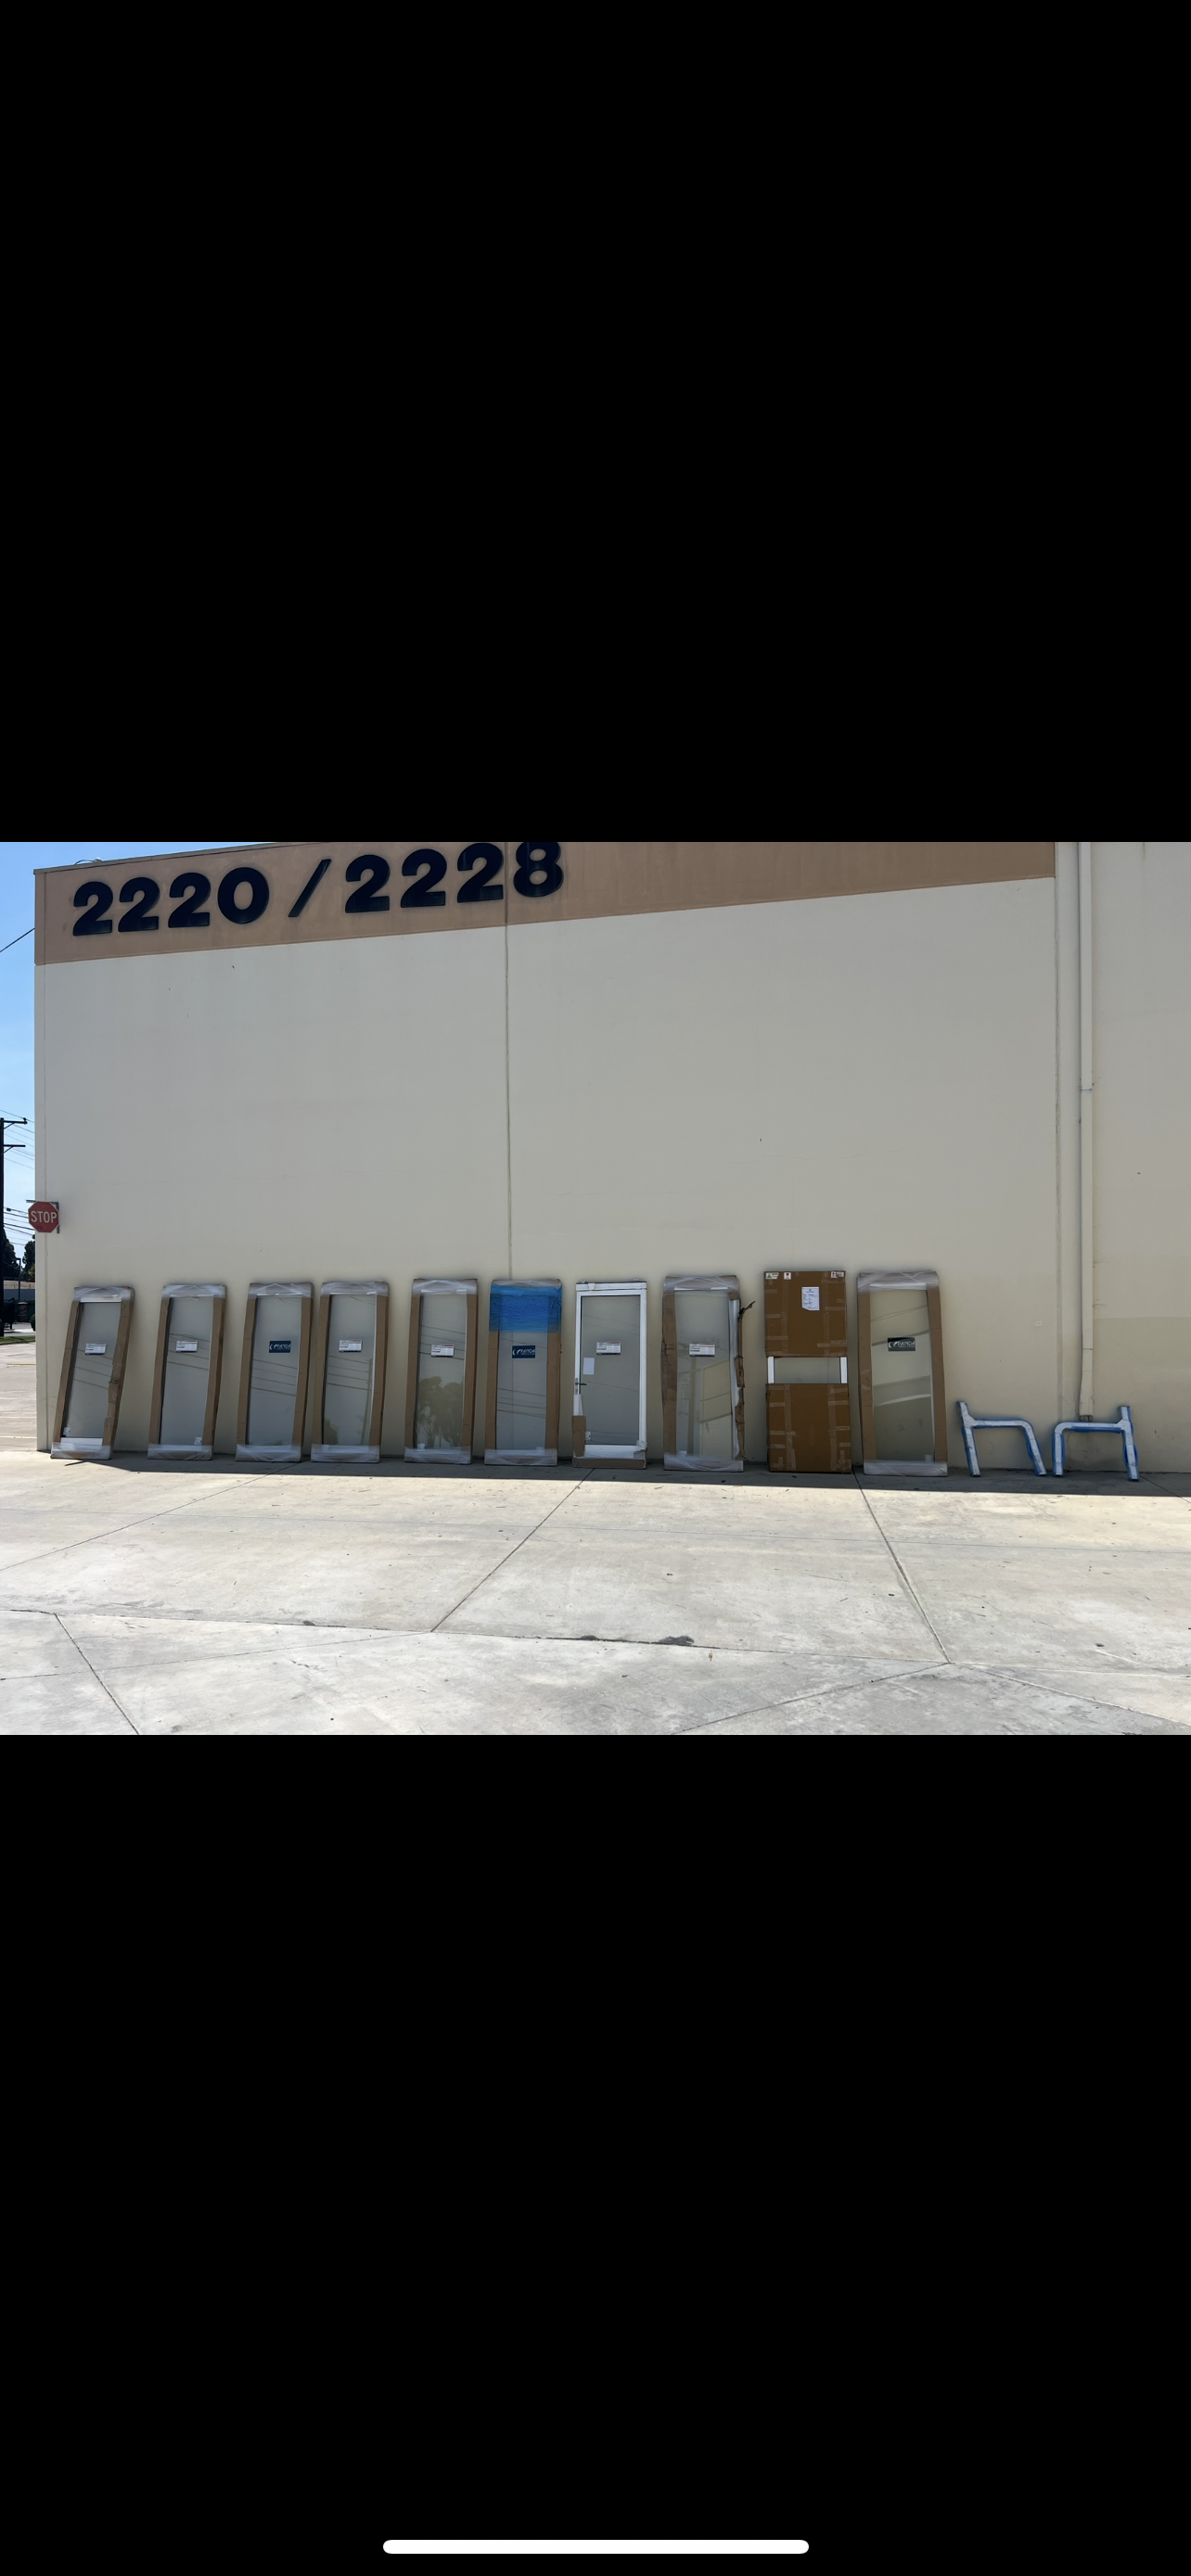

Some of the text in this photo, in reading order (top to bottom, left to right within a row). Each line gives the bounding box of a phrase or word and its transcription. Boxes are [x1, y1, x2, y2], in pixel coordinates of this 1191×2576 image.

[72, 842, 564, 937] 2220 / 2228
[31, 1210, 58, 1223] STOP
